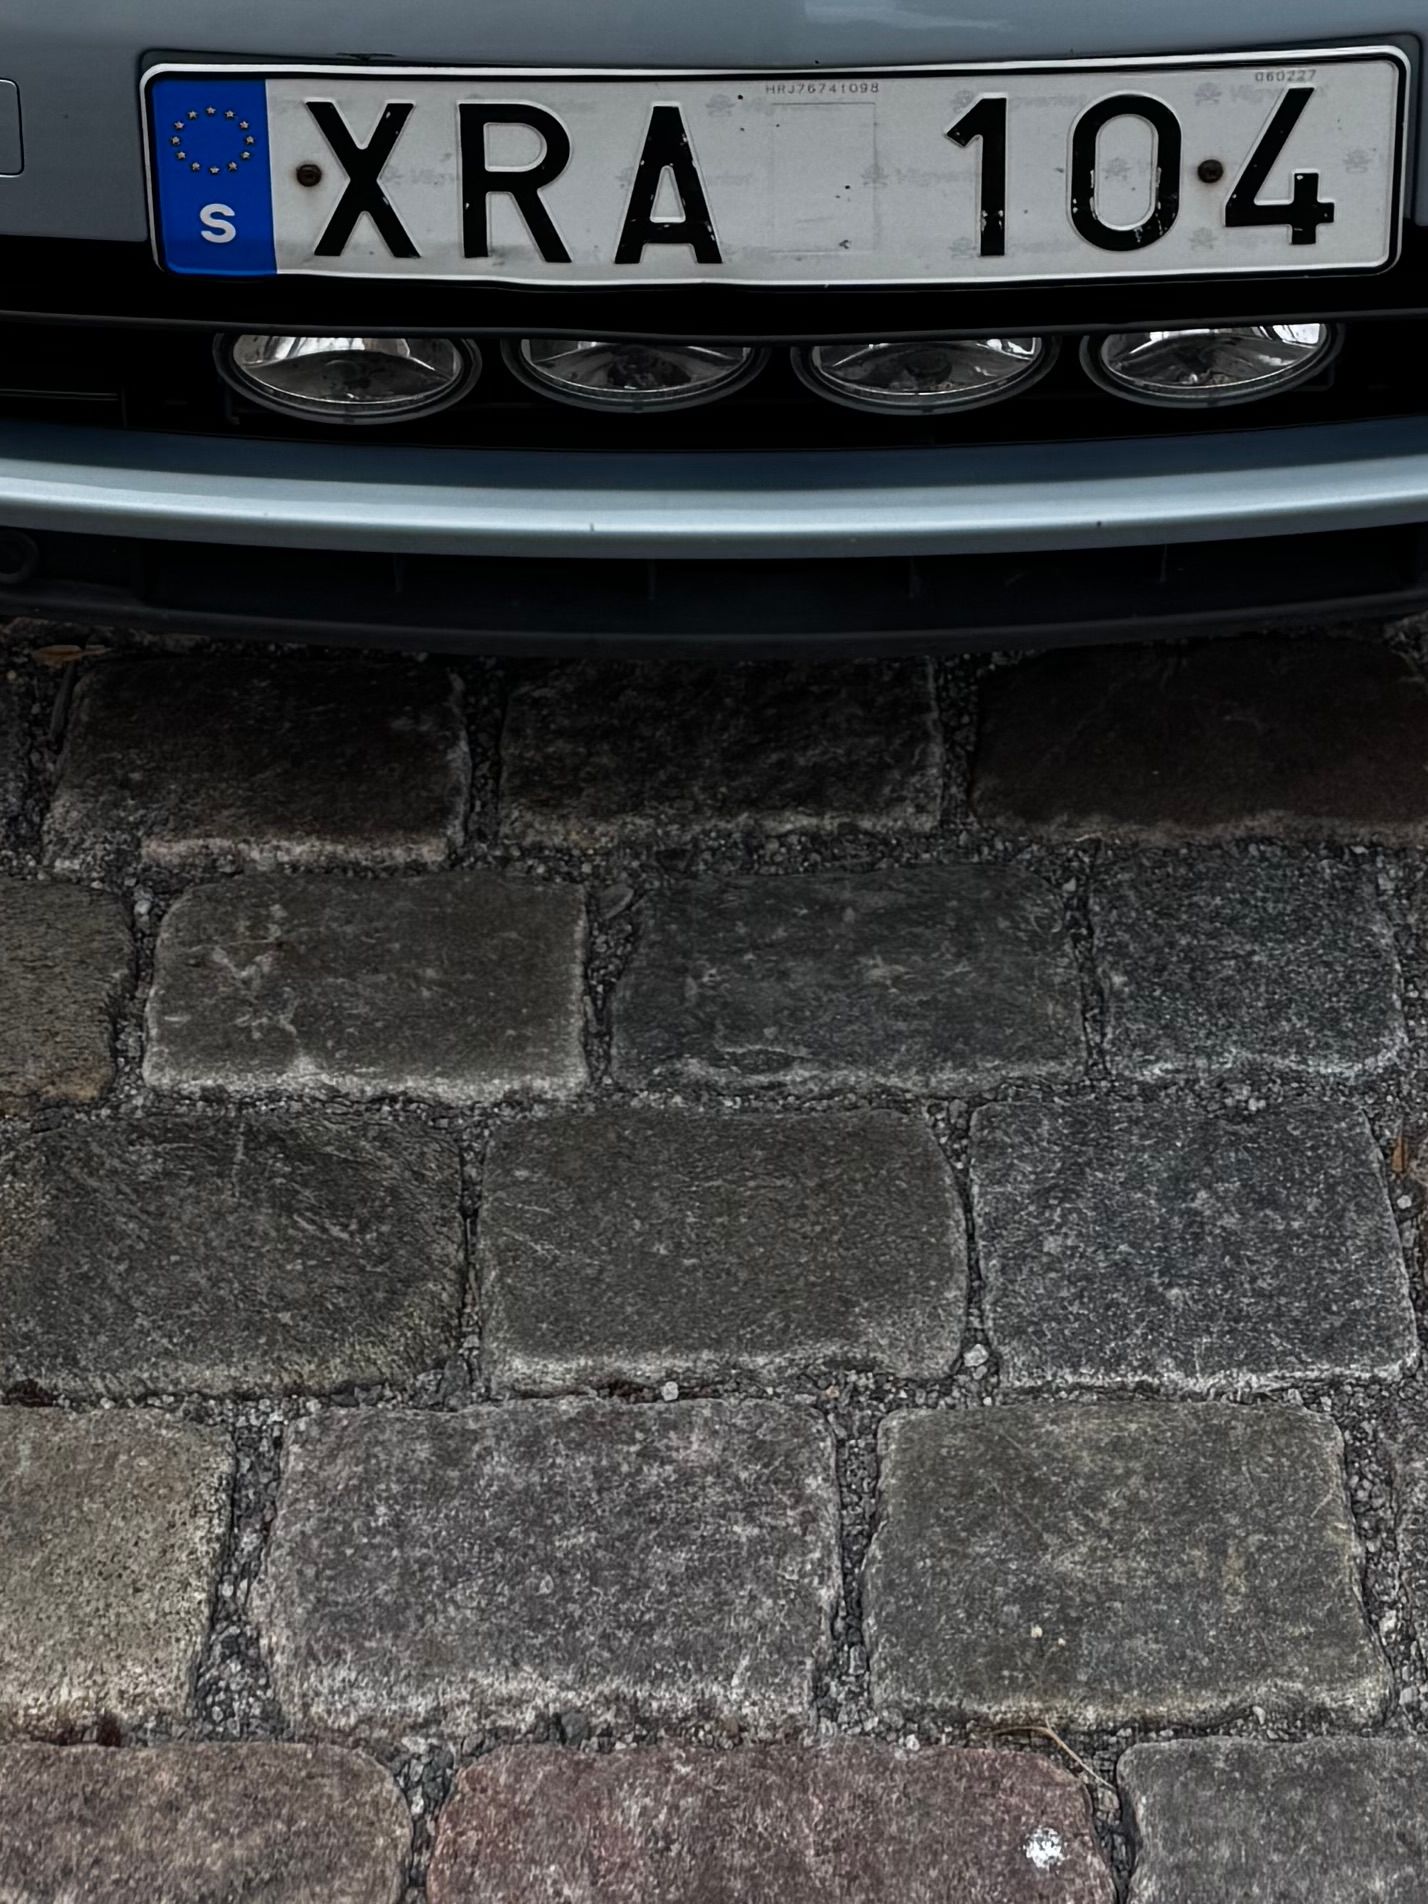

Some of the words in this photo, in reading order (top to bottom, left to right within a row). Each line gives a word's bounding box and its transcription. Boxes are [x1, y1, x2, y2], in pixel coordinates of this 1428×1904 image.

[1255, 69, 1317, 83] 060227
[304, 99, 723, 265] XRA
[944, 85, 1335, 257] 104
[199, 203, 237, 243] S
